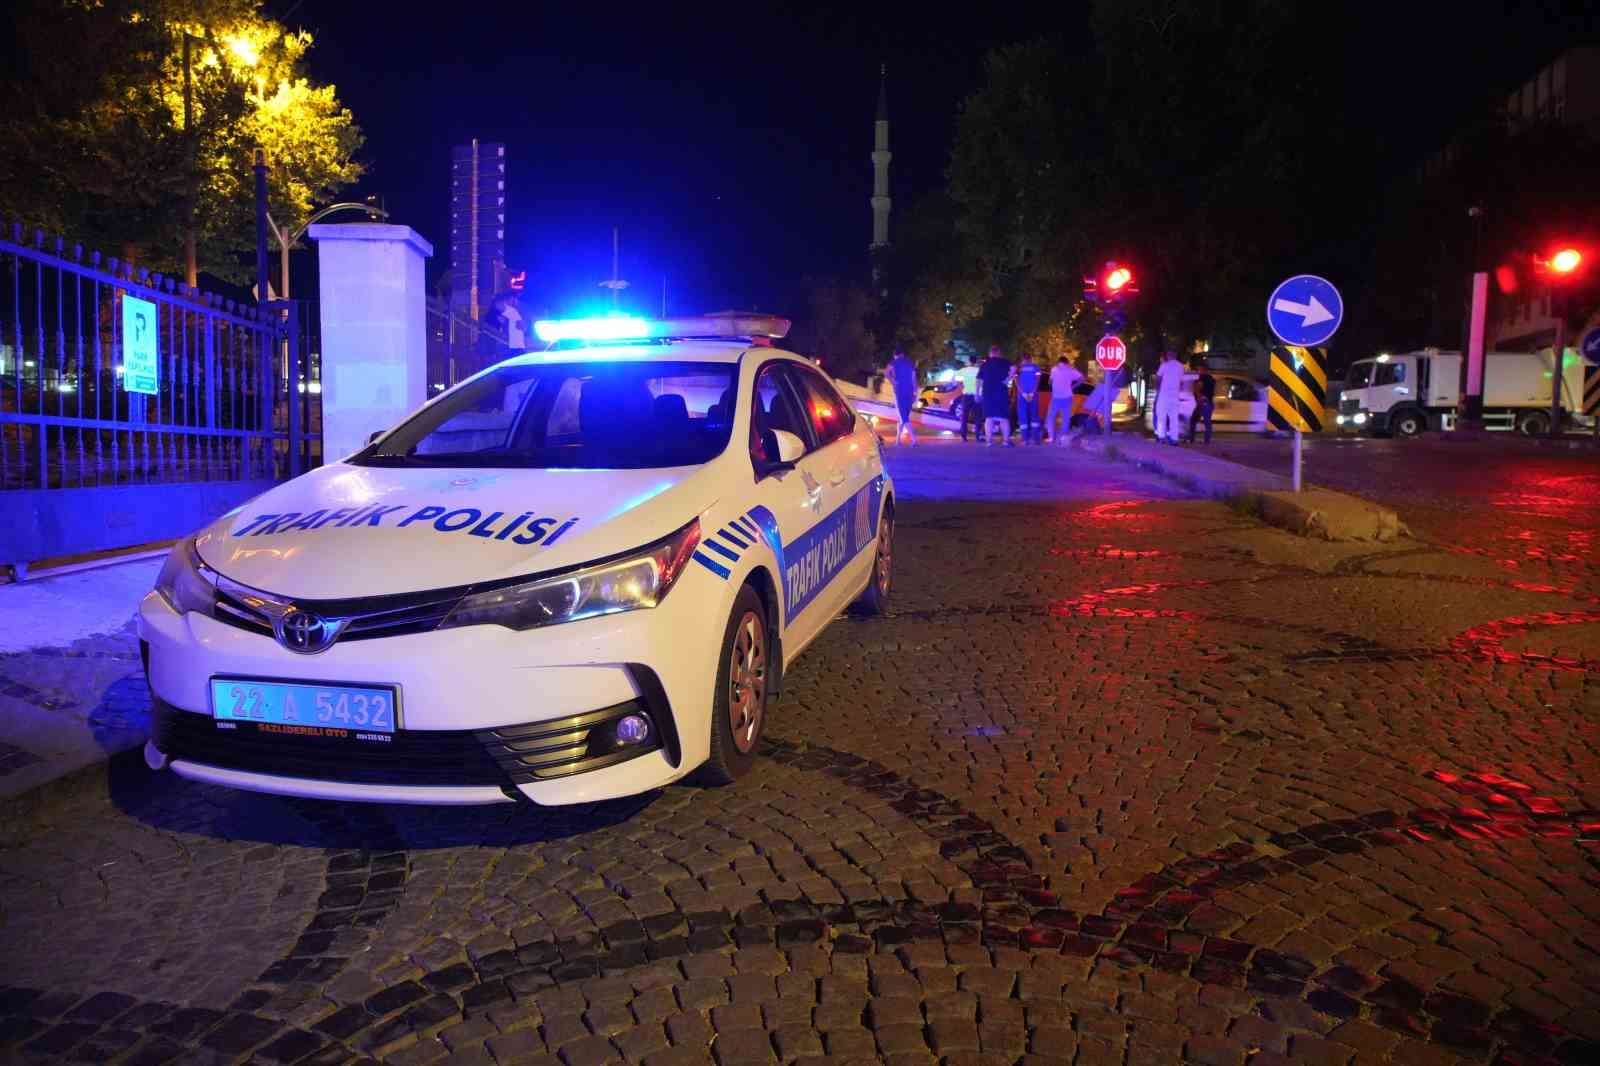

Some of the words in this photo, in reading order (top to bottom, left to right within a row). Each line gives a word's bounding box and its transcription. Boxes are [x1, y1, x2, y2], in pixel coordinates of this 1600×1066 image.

[1098, 346, 1123, 360] DUR
[232, 502, 408, 536] TRAFİK
[397, 506, 580, 546] POLİSİ
[787, 537, 821, 614] TRAFİK
[231, 687, 265, 719] 22
[283, 688, 299, 720] A
[316, 692, 387, 726] 5432
